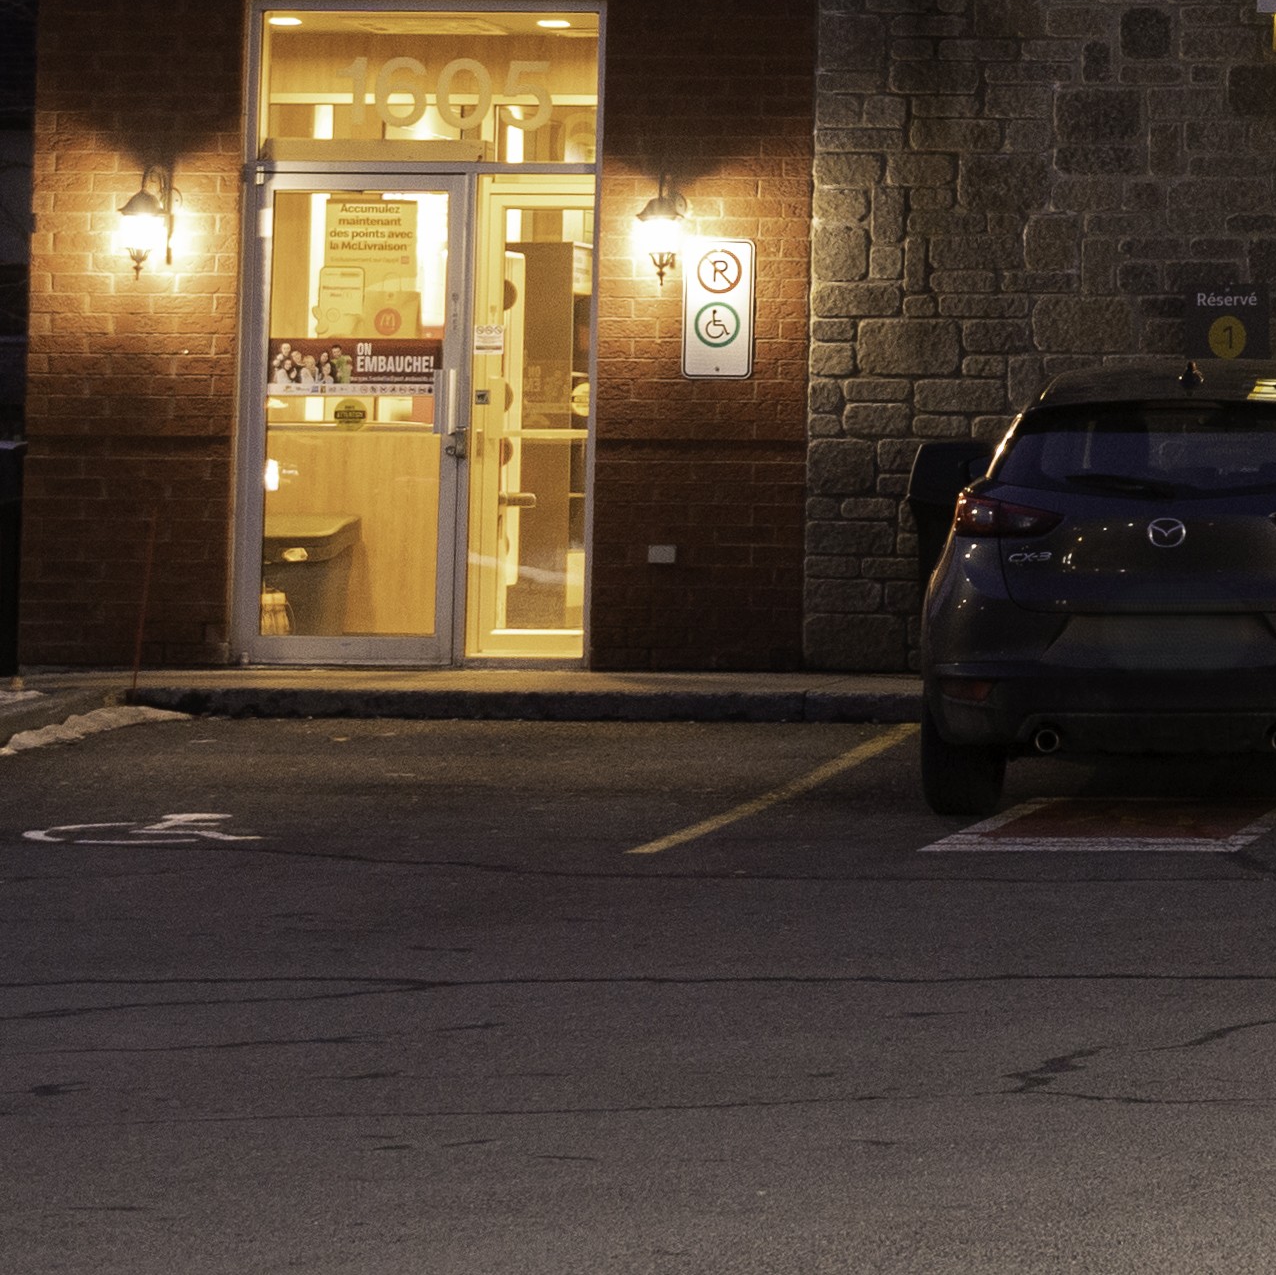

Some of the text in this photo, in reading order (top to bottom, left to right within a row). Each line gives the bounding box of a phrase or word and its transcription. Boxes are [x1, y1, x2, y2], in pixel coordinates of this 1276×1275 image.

[336, 56, 553, 131] 1605
[340, 204, 401, 214] Accumulez
[338, 215, 402, 226] maintenant
[329, 228, 413, 240] des points avec
[329, 241, 407, 251] la McLivraison
[1197, 292, 1258, 306] Réservé
[1223, 326, 1233, 349] 1
[356, 342, 372, 356] ON
[356, 356, 434, 373] EMBAUCHE!
[1008, 551, 1053, 562] CX-3
